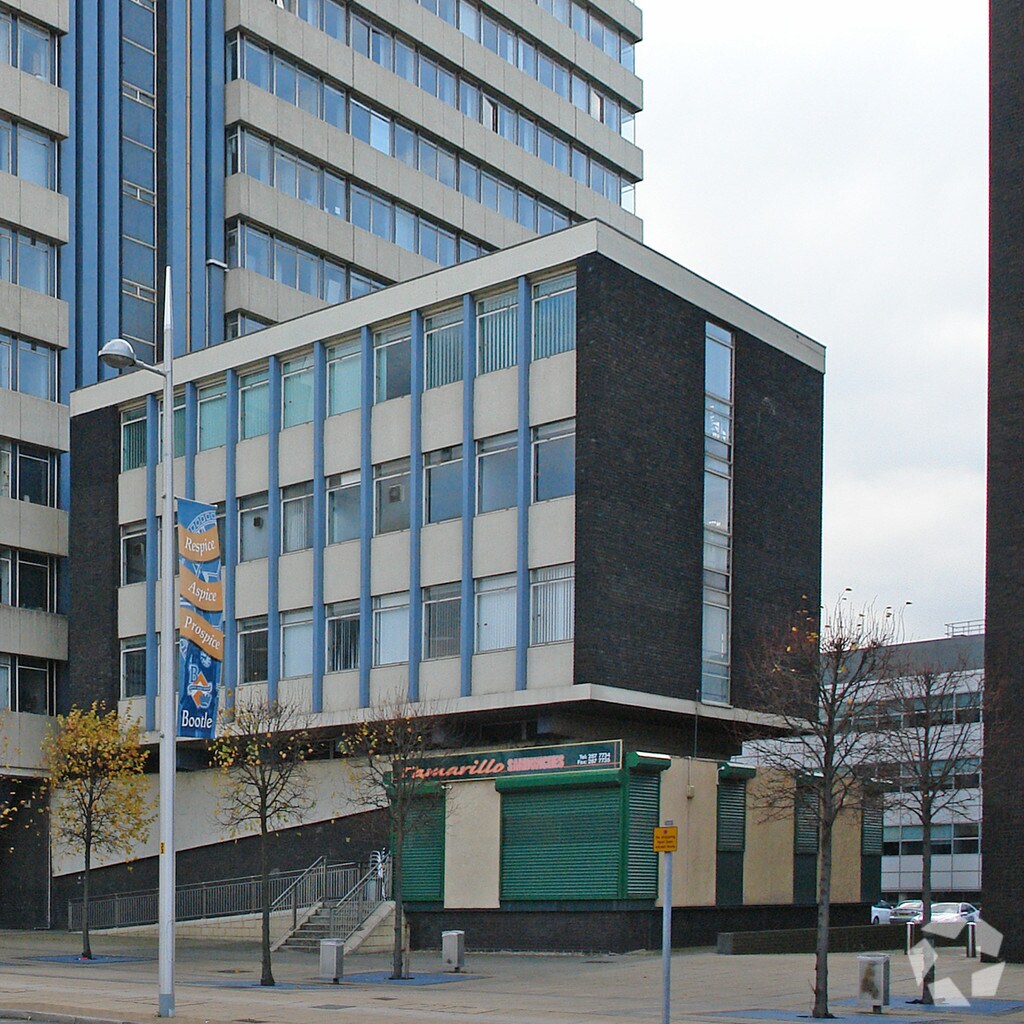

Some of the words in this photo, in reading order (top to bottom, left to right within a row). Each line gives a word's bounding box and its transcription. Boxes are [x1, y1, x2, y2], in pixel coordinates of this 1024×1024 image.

[185, 537, 216, 556] Respice
[188, 581, 217, 602] Aspice
[184, 615, 221, 650] Prospice
[181, 709, 213, 728] Bootle
